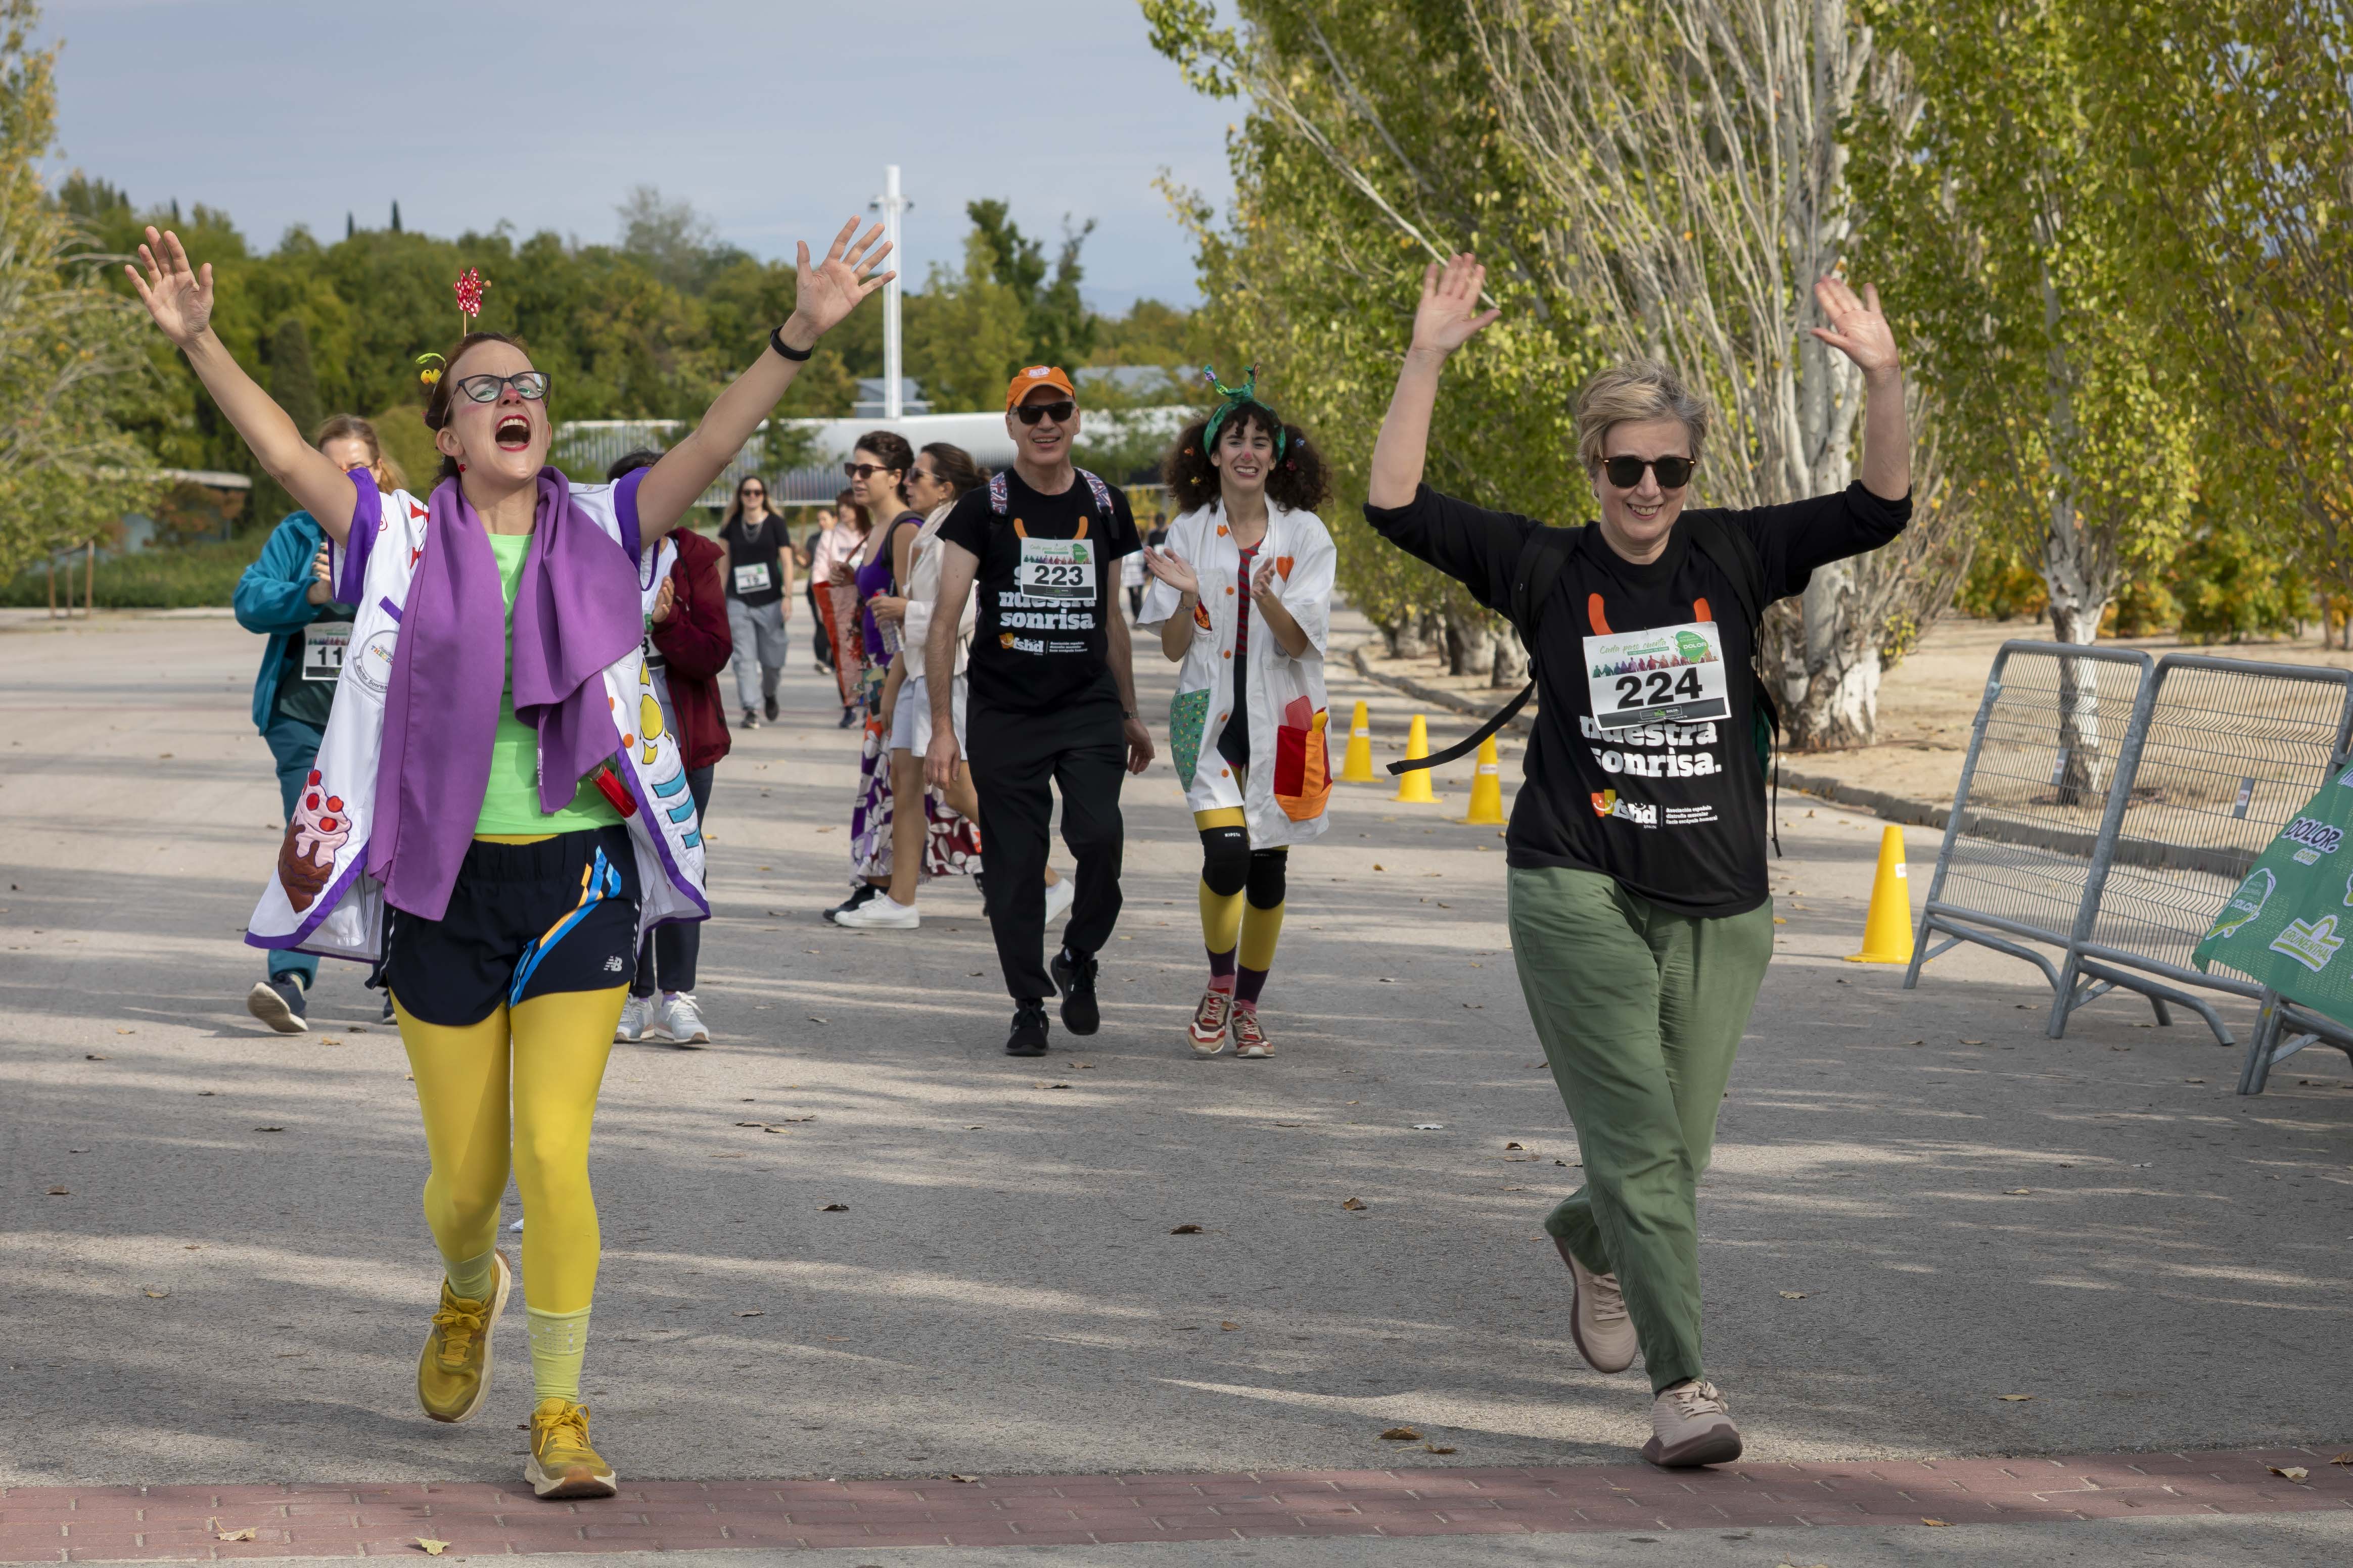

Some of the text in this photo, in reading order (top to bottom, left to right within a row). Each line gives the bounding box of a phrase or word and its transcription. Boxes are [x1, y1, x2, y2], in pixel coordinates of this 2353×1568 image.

[1034, 565, 1083, 586] 223
[1599, 644, 1620, 654] Cada
[1623, 643, 1640, 654] paso
[1643, 638, 1666, 649] cuenta
[356, 664, 388, 690] doctor Sonrisa
[1616, 667, 1703, 709] 224
[2296, 849, 2318, 863] com
